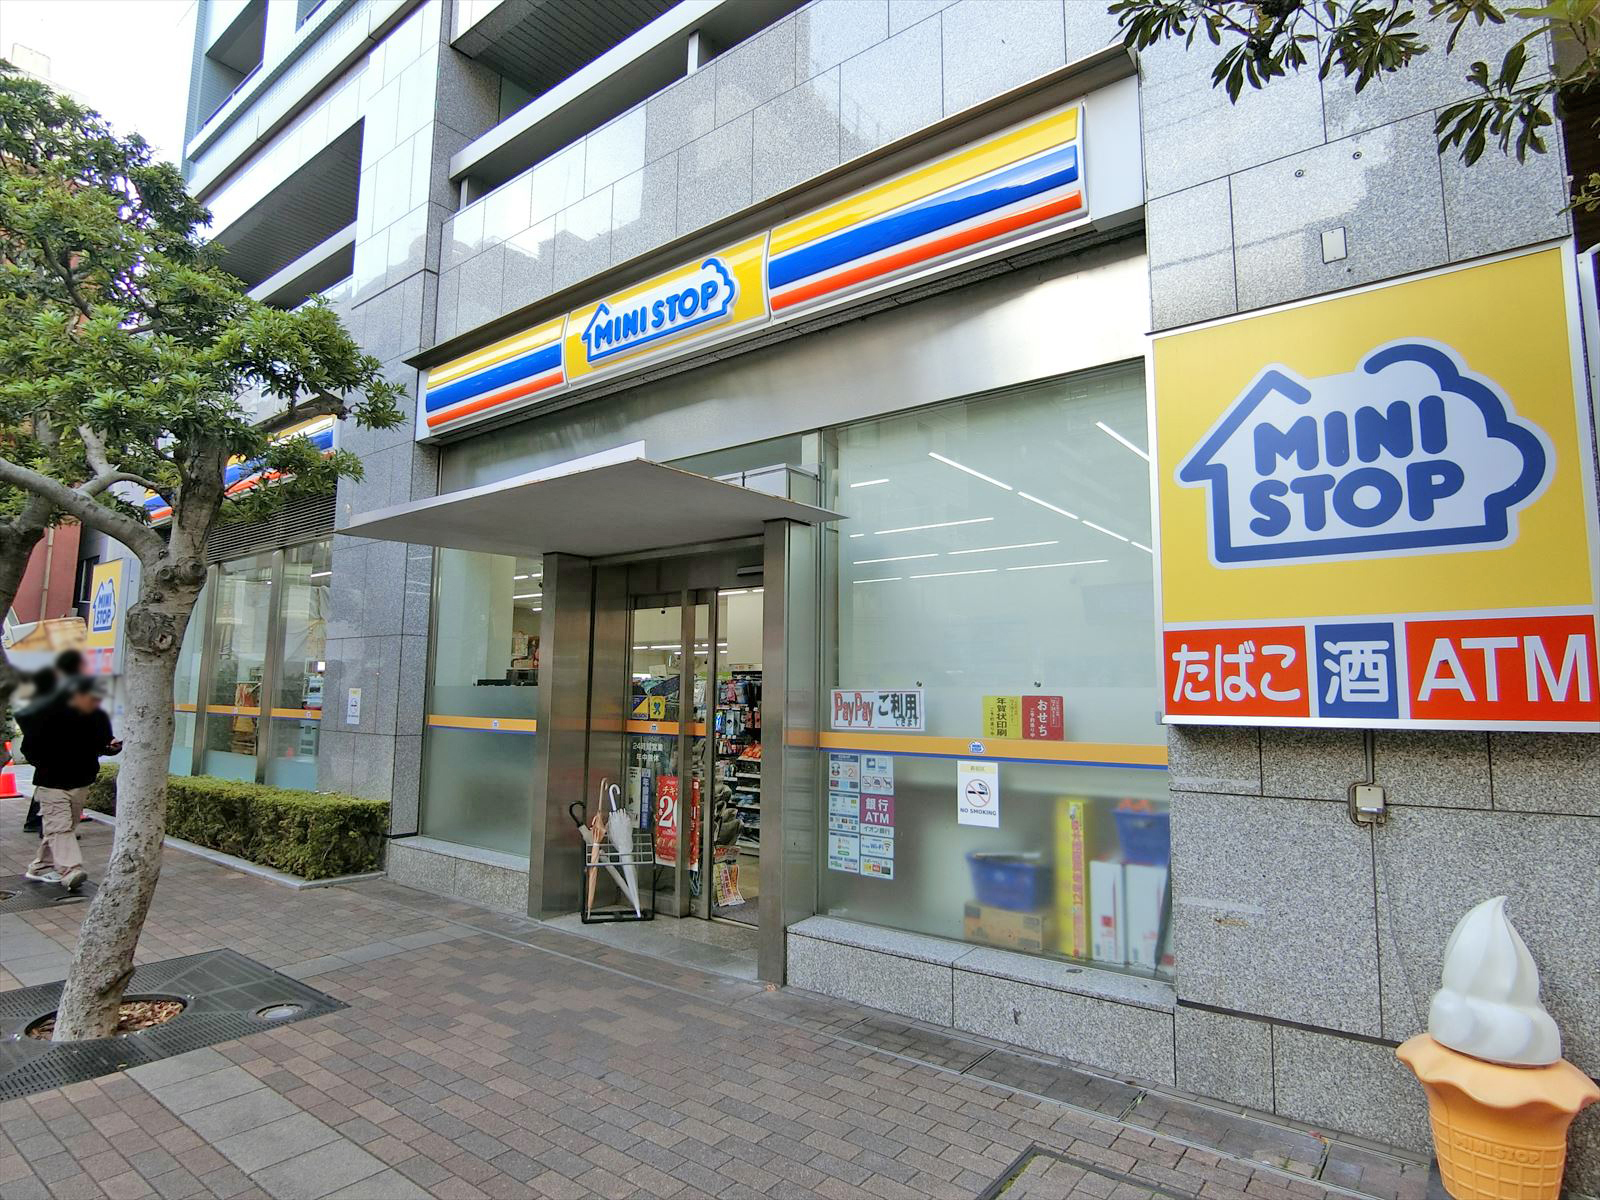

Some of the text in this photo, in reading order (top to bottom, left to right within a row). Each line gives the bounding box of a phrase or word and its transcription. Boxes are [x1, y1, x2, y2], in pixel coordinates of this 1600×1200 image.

[595, 280, 718, 350] MINI STOP
[1253, 394, 1448, 476] MINI
[1249, 459, 1465, 537] STOP
[96, 609, 111, 625] STOP
[1171, 639, 1301, 702] たばこ
[1323, 639, 1390, 704] 酒
[1416, 633, 1592, 703] ATM
[834, 691, 917, 727] PayPay ご利用
[996, 697, 1008, 737] 年賀状印刷
[1037, 699, 1048, 737] おせち
[865, 797, 889, 812] 銀行
[865, 811, 889, 824] ATM
[864, 825, 891, 836] イオン銀行
